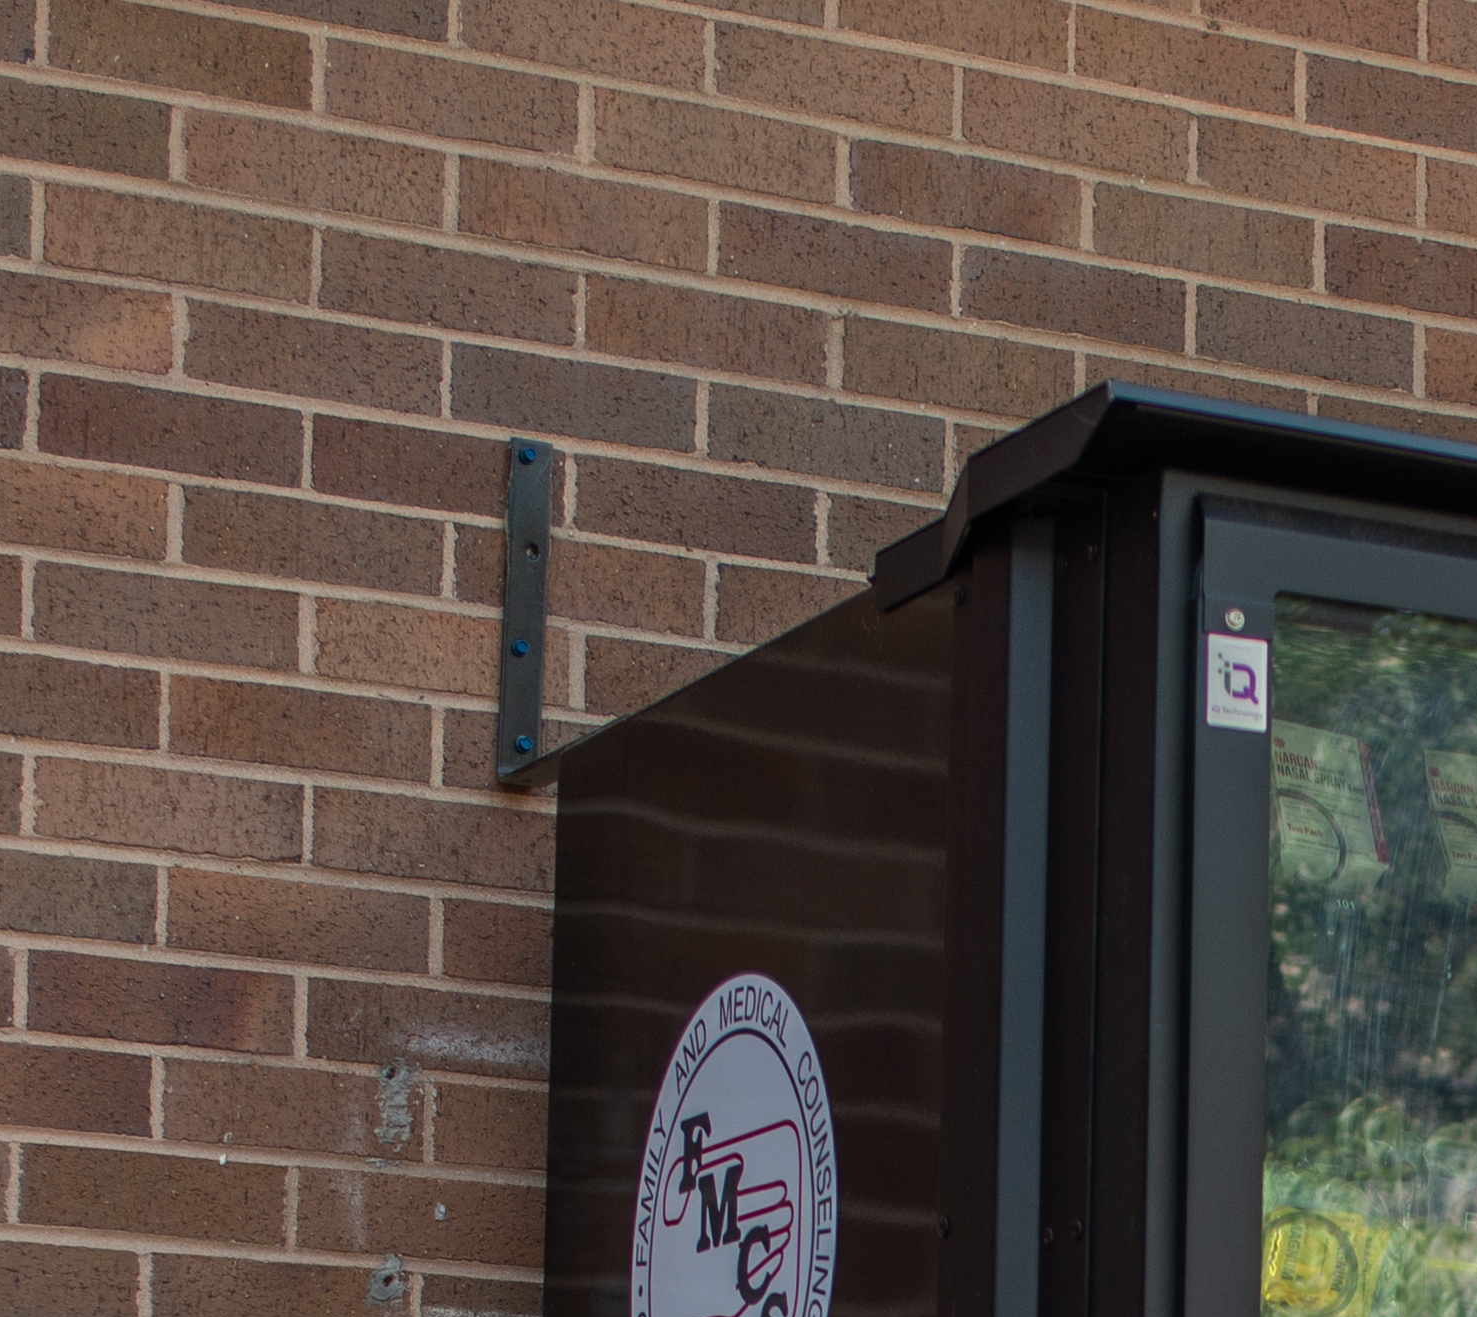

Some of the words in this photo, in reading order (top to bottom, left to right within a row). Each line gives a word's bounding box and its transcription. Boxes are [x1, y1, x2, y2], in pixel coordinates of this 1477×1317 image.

[1222, 706, 1263, 721] Technology
[1274, 751, 1318, 770] NARCAN
[636, 1107, 667, 1267] FAMILY
[674, 1018, 707, 1096] AND
[719, 984, 789, 1048] MEDICAL
